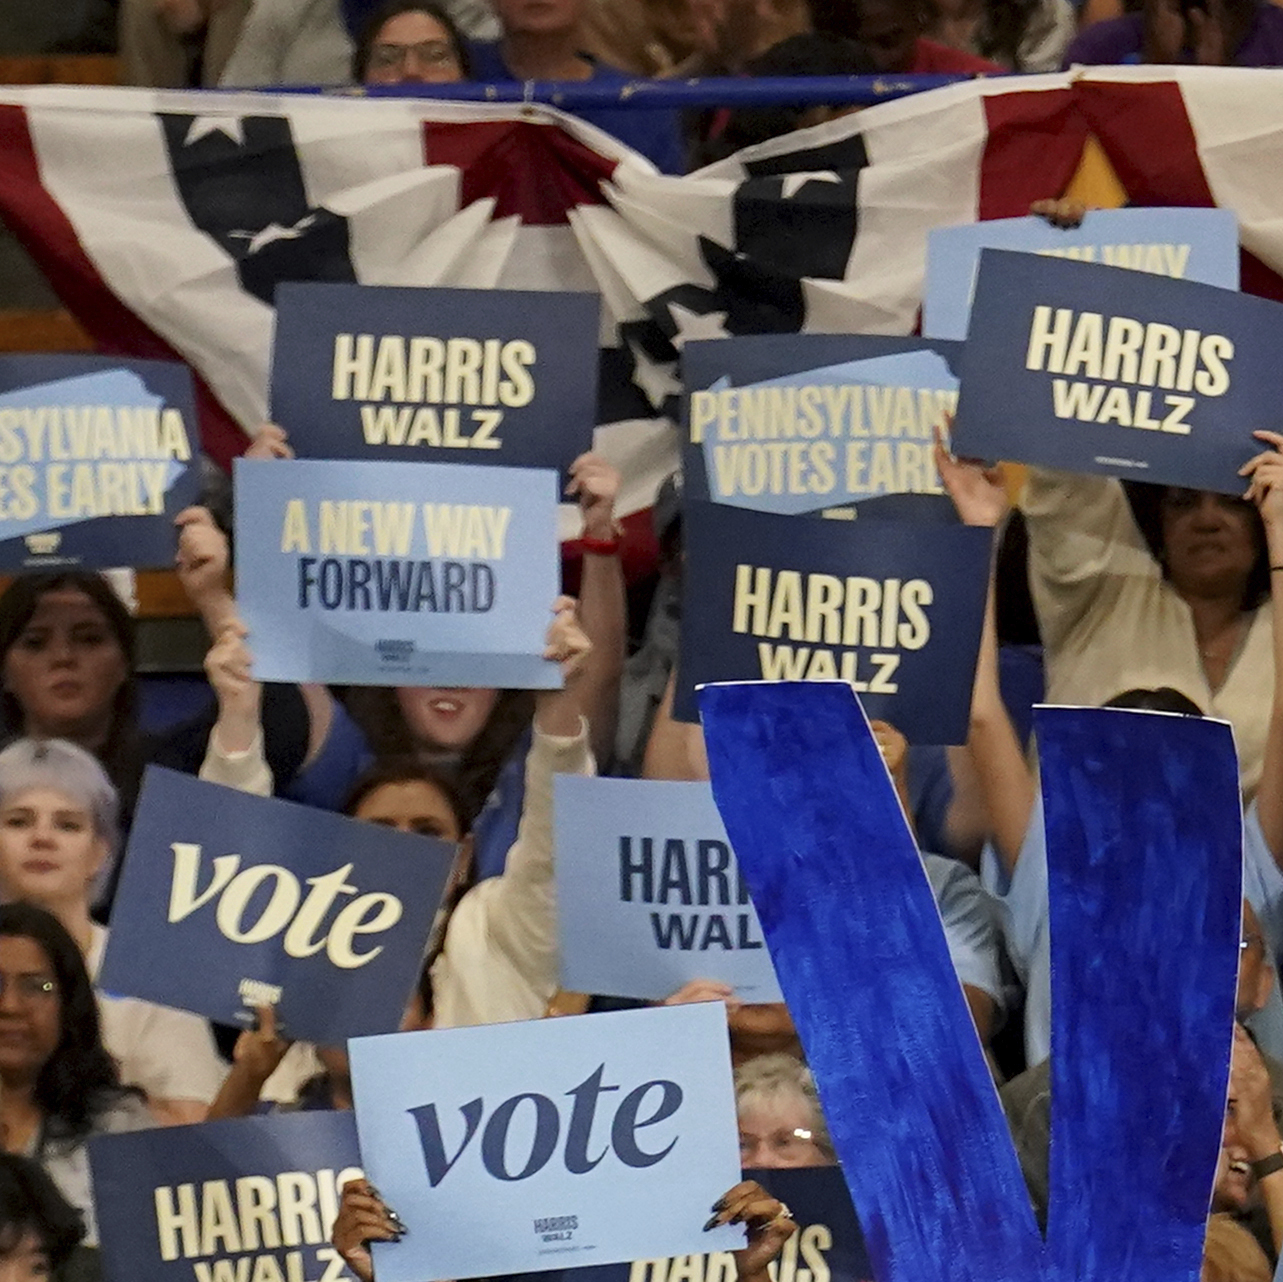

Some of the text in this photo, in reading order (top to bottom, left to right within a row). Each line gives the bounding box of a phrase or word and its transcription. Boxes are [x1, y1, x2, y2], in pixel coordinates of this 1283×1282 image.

[332, 333, 536, 409] HARRIS
[1026, 305, 1235, 397] HARRIS
[361, 407, 502, 450] WALZ
[1052, 378, 1196, 435] WALZ
[45, 459, 166, 518] EARLY
[713, 442, 835, 497] VOTES
[281, 501, 512, 559] A NEW WAY
[298, 558, 496, 614] FORWARD
[732, 564, 935, 651] HARRIS
[757, 642, 899, 694] WALZ
[167, 842, 403, 970] vote
[406, 1062, 684, 1189] vote
